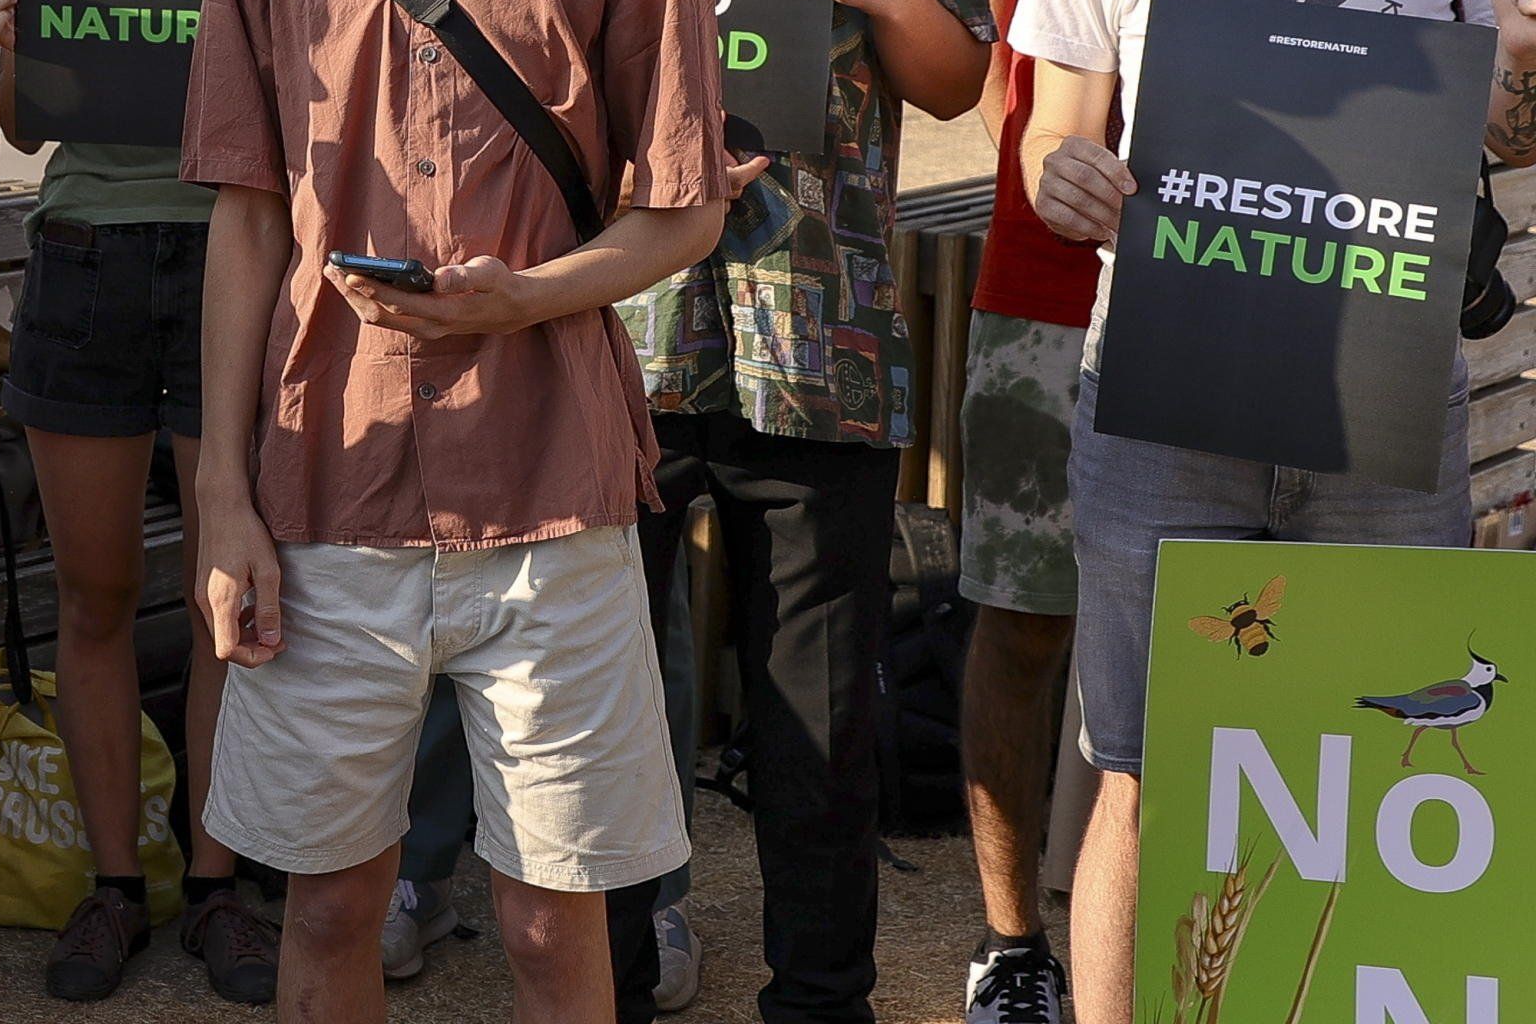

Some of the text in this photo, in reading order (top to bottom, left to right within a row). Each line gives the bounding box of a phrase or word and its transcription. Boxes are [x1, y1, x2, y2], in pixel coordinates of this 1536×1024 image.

[1269, 35, 1368, 55] #RESTORENATURE
[1158, 168, 1438, 243] #RESTORE
[1153, 215, 1431, 301] NATURE
[1206, 726, 1495, 893] No
